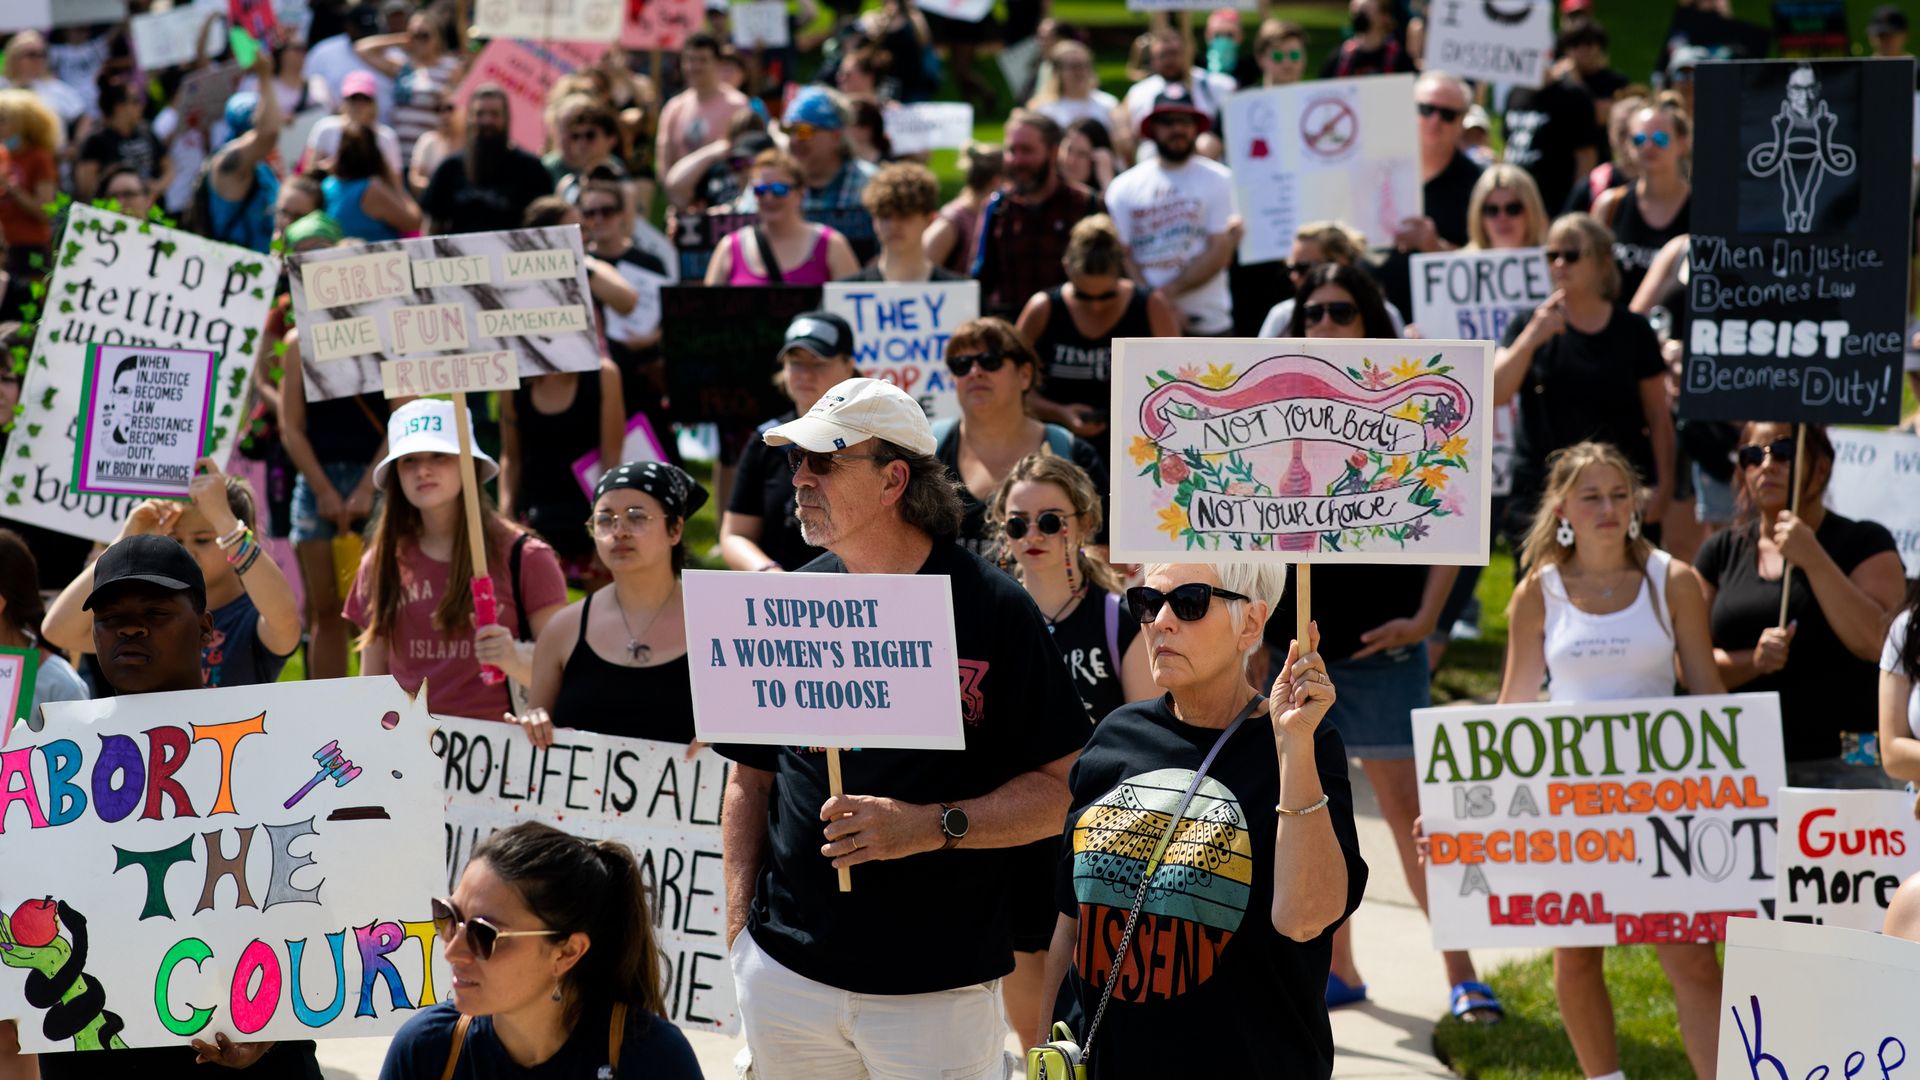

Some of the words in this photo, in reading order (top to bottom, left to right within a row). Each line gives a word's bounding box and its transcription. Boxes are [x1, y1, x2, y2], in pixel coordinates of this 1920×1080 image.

[421, 256, 484, 286] JUST
[508, 254, 569, 277] WANNA
[1689, 234, 1764, 273] When
[1772, 239, 1884, 278] Injustice
[844, 291, 946, 332] THEY
[1691, 274, 1811, 313] Becomes
[1818, 276, 1856, 298] Law
[78, 277, 236, 363] telling
[314, 319, 375, 355] HAVE
[393, 306, 465, 350] FUN
[484, 308, 579, 335] DAMENTAL
[1690, 318, 1902, 359] RESISTence
[136, 370, 190, 386] INJUSTICE
[138, 355, 170, 369] WHEN
[395, 352, 509, 395] RIGHTS
[134, 385, 183, 401] BECOMES
[1686, 356, 1800, 393] Becomes
[1801, 364, 1892, 417] Duty!
[131, 415, 194, 433] RESISTANCE
[132, 400, 155, 414] LAW
[404, 415, 442, 435] 1973
[129, 431, 177, 446] BECOMES
[1203, 410, 1270, 449] NOT
[96, 460, 111, 475] MY
[113, 462, 137, 477] BODY
[139, 463, 155, 477] MY
[157, 464, 190, 480] CHOICE
[127, 446, 156, 460] DUTY.
[1198, 496, 1250, 529] NOT
[745, 598, 757, 626] I
[764, 598, 878, 628] SUPPORT
[409, 640, 471, 658] ISLAND
[711, 638, 726, 667] A
[733, 638, 845, 668] WOMEN'S
[852, 640, 933, 668] RIGHT
[752, 679, 786, 708] TO
[794, 680, 891, 710] CHOOSE
[1424, 706, 1746, 784] ABORTION
[0, 711, 268, 834] ABORT
[601, 748, 641, 813] IS
[1454, 784, 1496, 820] IS
[1507, 783, 1540, 817] A
[1546, 775, 1769, 817] PERSONAL
[1646, 814, 1778, 883] NOT
[1799, 807, 1906, 859] Guns
[112, 815, 326, 922] THE
[1459, 863, 1493, 897] A
[1487, 892, 1613, 926] LEGAL
[1615, 910, 1758, 946] DEBAT
[1075, 903, 1235, 1003] ISSENT
